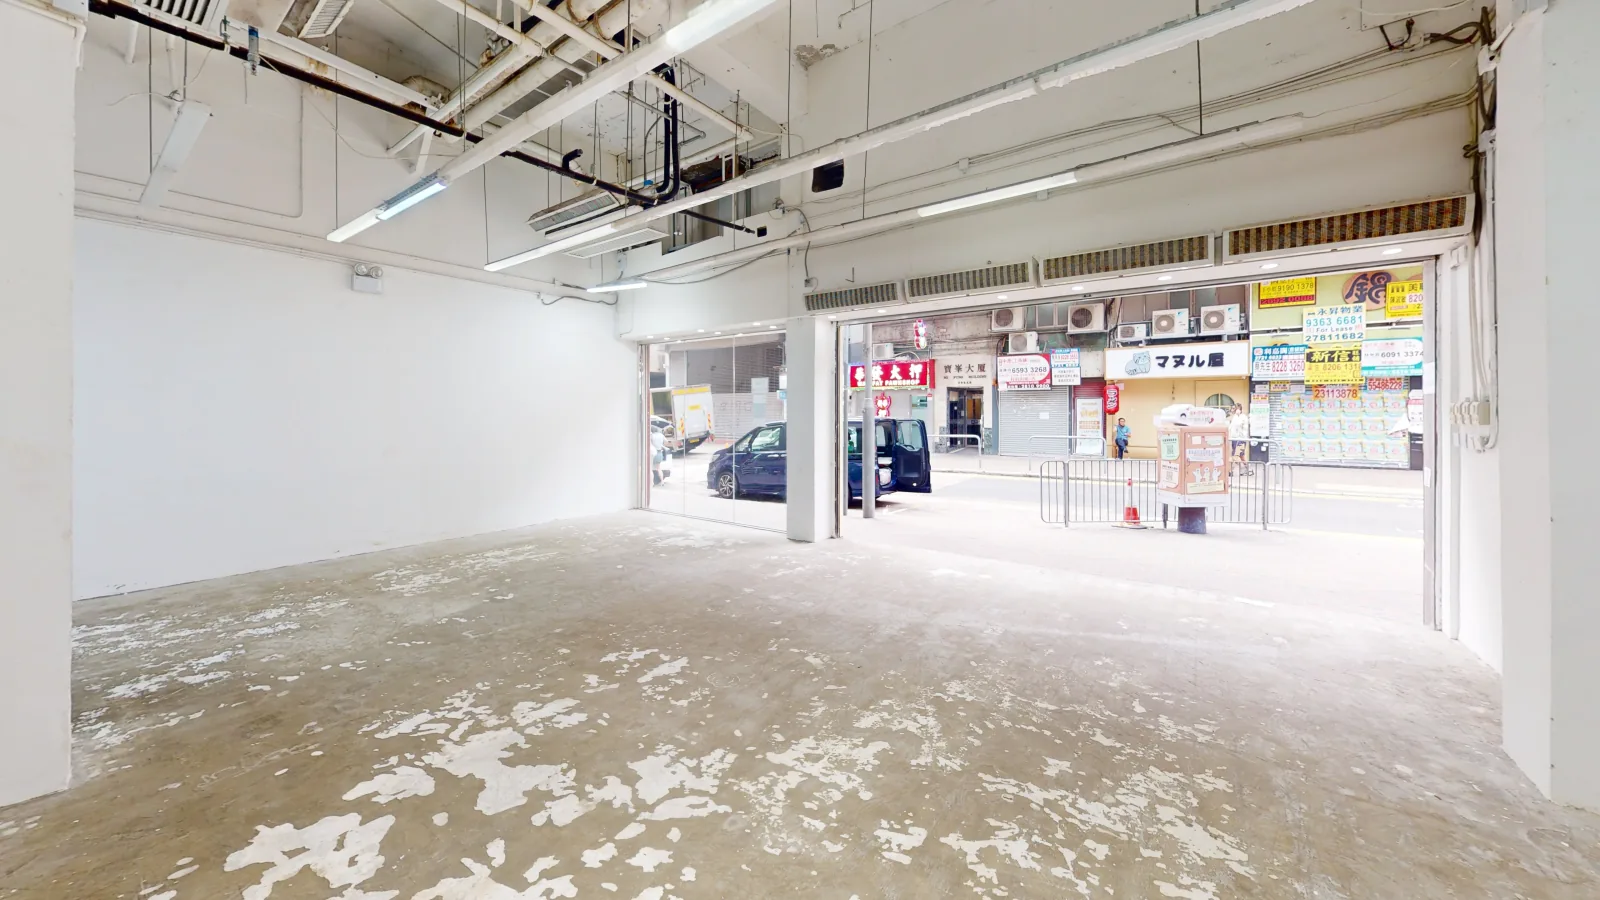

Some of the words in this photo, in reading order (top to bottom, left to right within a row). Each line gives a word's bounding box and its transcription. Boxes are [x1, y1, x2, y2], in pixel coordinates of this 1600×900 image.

[1306, 317, 1332, 328] 9363
[1336, 315, 1362, 325] 6681
[1305, 332, 1364, 342] 27811682
[1155, 352, 1225, 368] マヌル屋
[1314, 388, 1358, 399] 23113878
